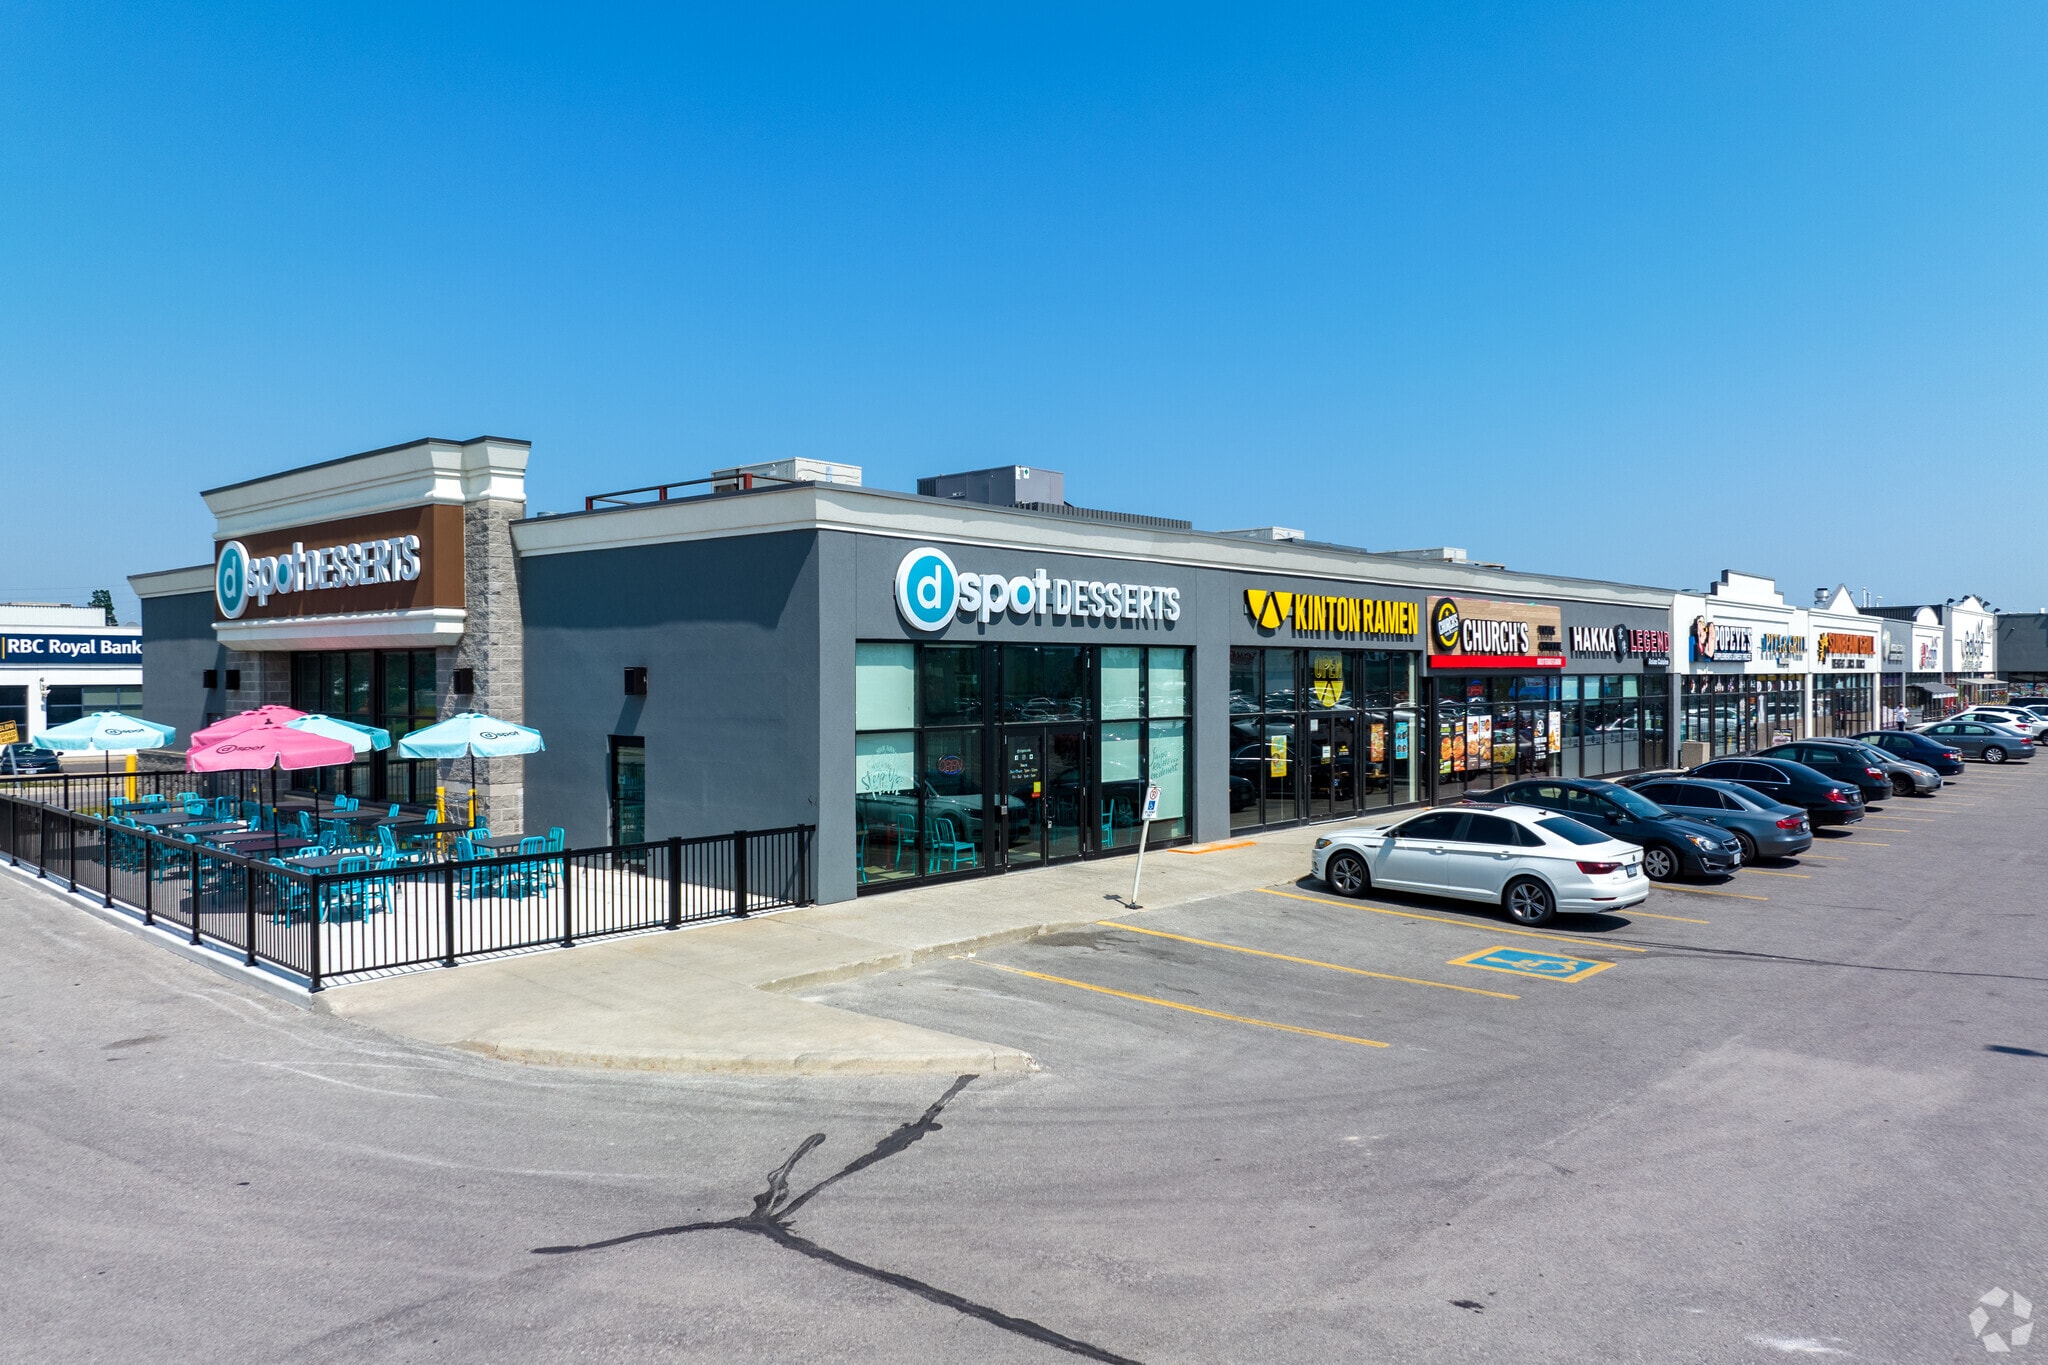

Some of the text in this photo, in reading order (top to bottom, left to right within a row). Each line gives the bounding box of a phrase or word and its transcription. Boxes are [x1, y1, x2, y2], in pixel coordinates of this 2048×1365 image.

[305, 534, 421, 591] DESSERTS
[1052, 578, 1181, 622] DESSERTS
[1295, 593, 1419, 635] KINTON RAMEN
[7, 638, 143, 657] RBC Royal Bank
[1462, 619, 1529, 655] CHURCH'S
[1573, 626, 1617, 652] HAKKA
[1630, 629, 1670, 653] LEGEND
[1314, 655, 1343, 679] OPEN
